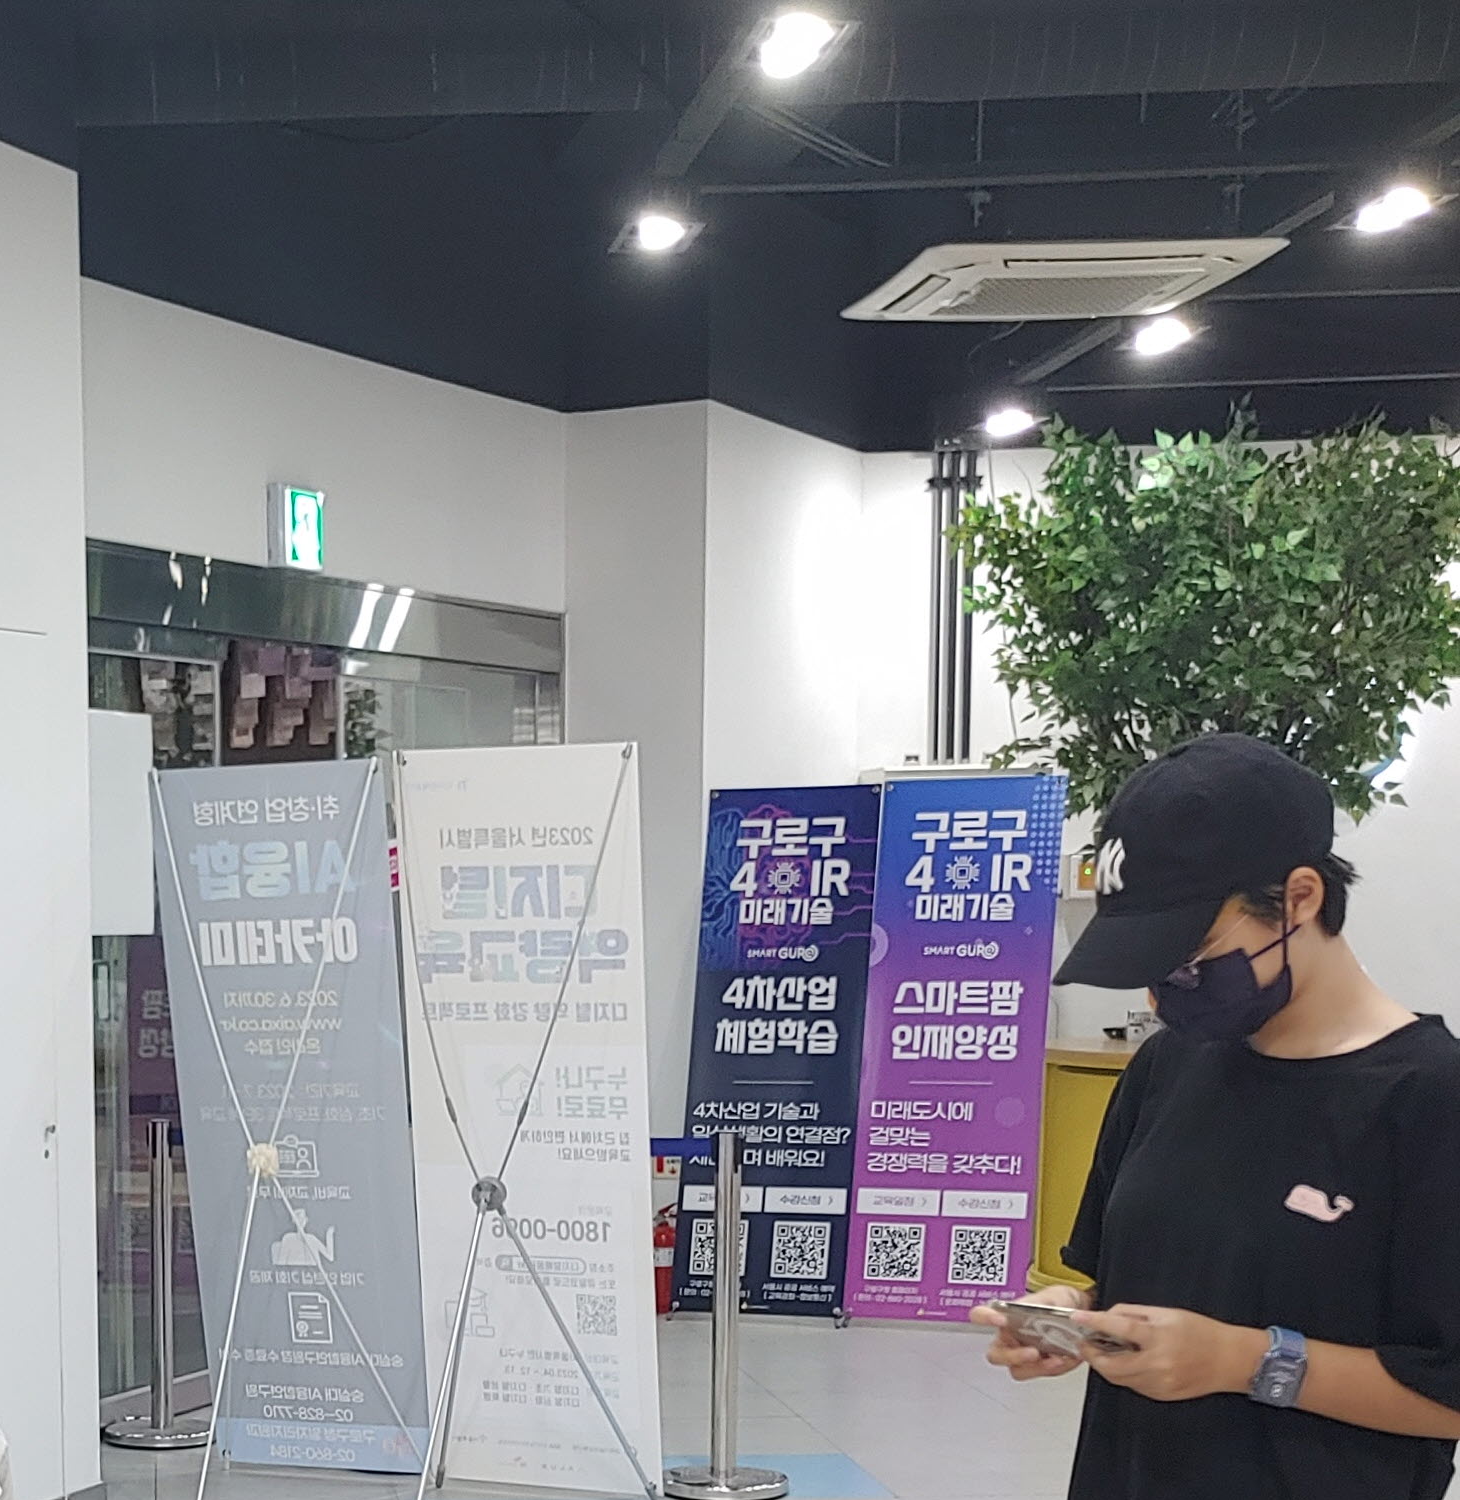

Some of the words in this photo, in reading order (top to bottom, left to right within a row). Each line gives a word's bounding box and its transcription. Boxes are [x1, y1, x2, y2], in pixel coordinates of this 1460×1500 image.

[736, 817, 846, 859] 구로구
[912, 810, 1027, 853] 구로구
[730, 857, 757, 897] 4
[906, 856, 934, 894] 4
[740, 897, 834, 925] 미래기술
[915, 894, 1015, 923] 미래기술
[747, 946, 777, 959] SMART
[923, 945, 954, 957] SMART
[722, 976, 838, 1013] 4차산업
[893, 980, 1024, 1017] 스마트팜
[715, 1019, 838, 1055] 체험학습
[892, 1023, 1018, 1062] 인재양성
[693, 1101, 761, 1120] 4차산업
[763, 1102, 821, 1121] 기술과
[870, 1100, 974, 1121] 미래도시에
[786, 1125, 852, 1145] 연결점?
[868, 1125, 931, 1147] 걸맞는
[765, 1149, 826, 1168] 배워요!
[866, 1152, 949, 1174] 경쟁력을
[952, 1153, 1022, 1176] 갖추다!
